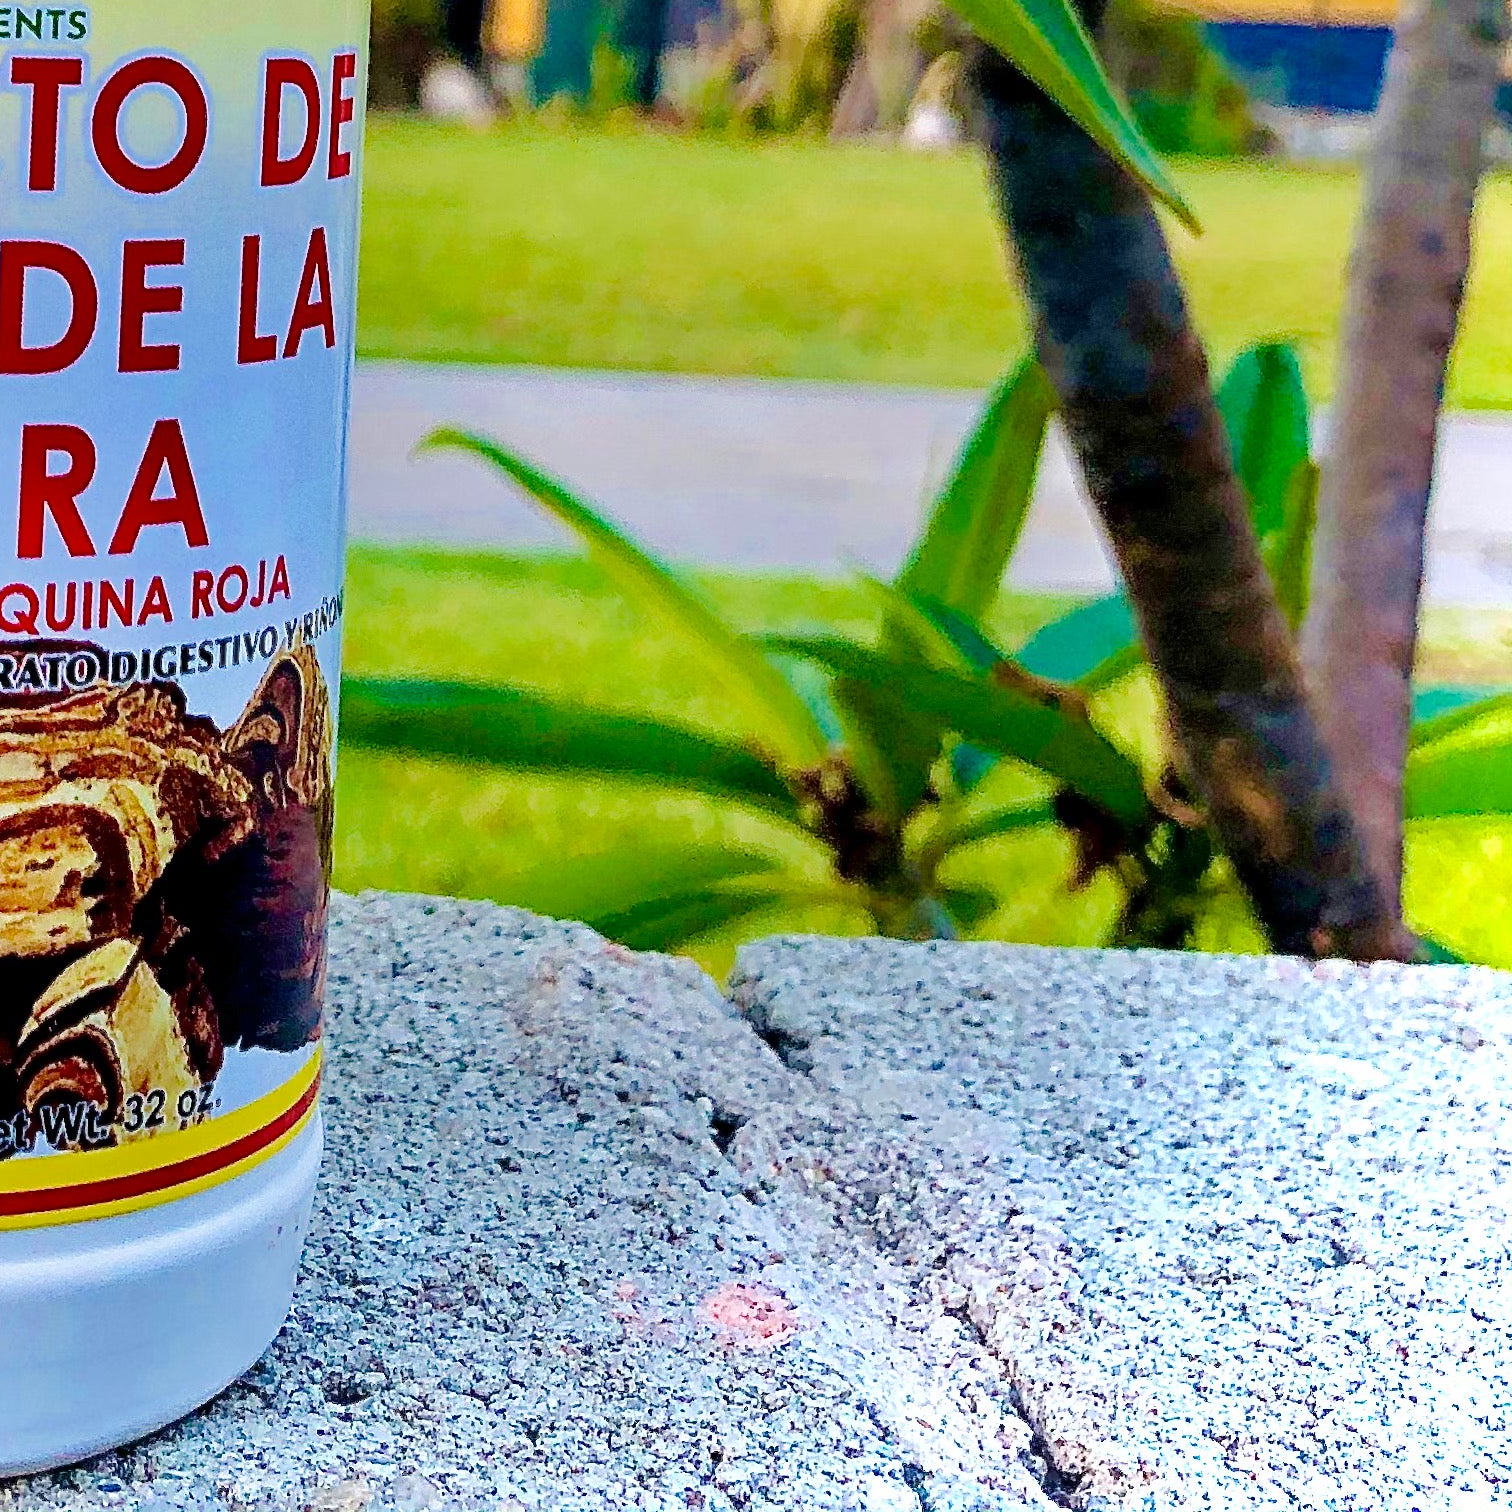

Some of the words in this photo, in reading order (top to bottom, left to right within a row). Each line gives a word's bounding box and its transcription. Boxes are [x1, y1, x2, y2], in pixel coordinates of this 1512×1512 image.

[260, 53, 356, 188] DE
[237, 226, 336, 365] LA
[191, 554, 291, 620] ROJA
[110, 625, 279, 685] DIGESTIVO
[284, 617, 298, 651] Y
[40, 1101, 110, 1151] Wt.
[124, 1089, 166, 1133] 32
[177, 1083, 222, 1118] oz.
